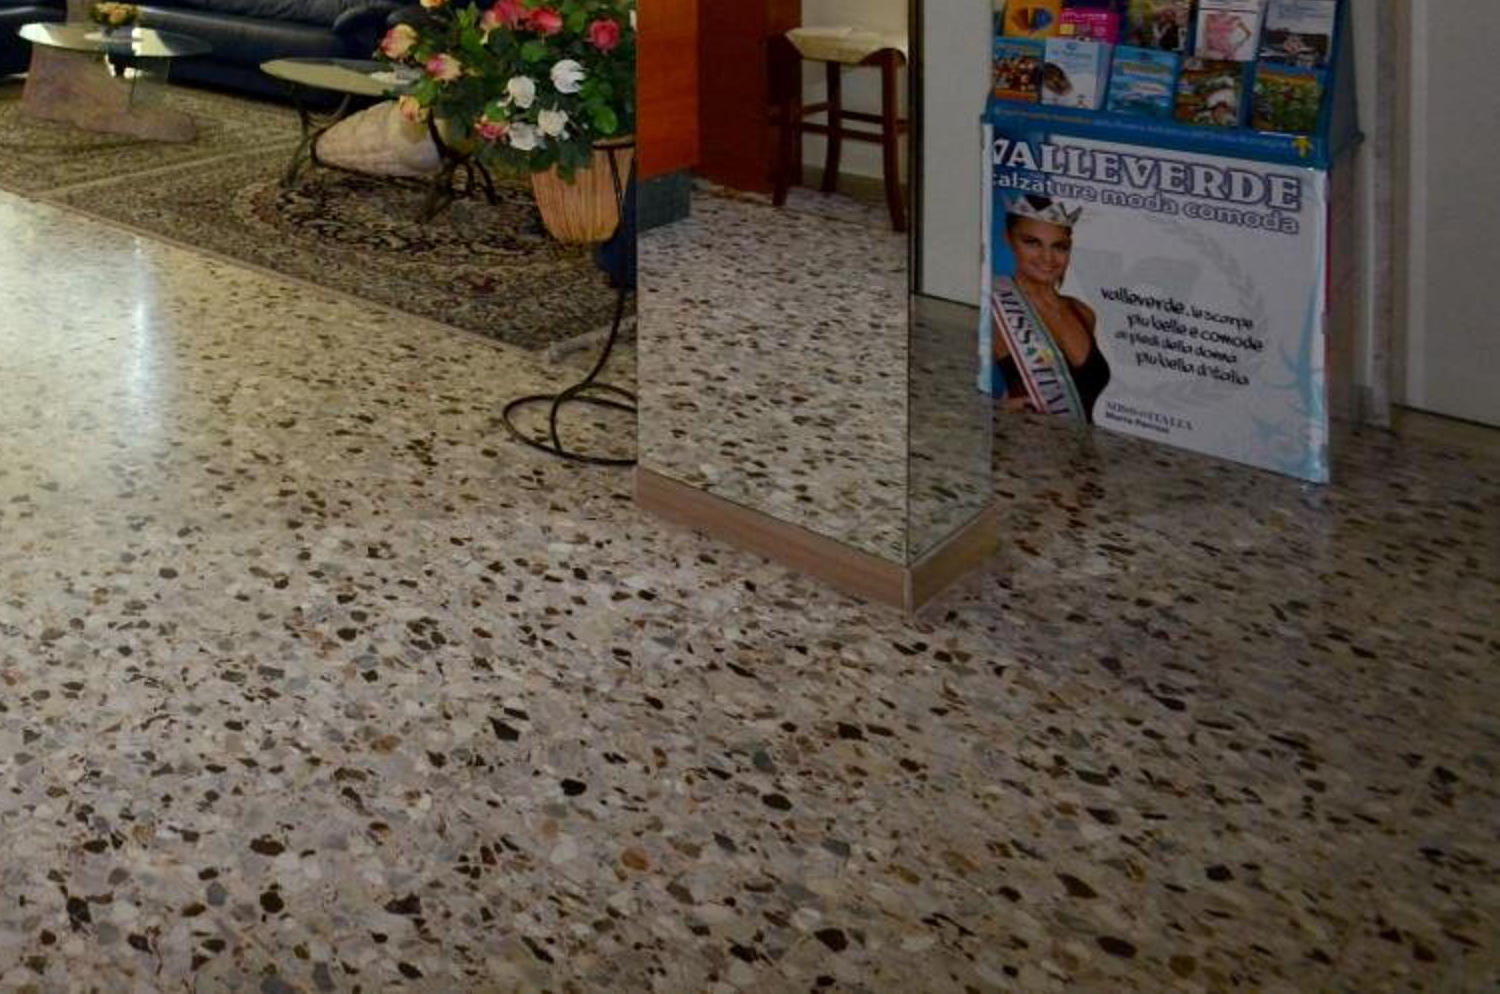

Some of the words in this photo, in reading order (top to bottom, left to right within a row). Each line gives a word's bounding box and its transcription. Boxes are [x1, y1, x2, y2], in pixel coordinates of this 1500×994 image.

[992, 171, 1097, 203] alzature
[1101, 188, 1179, 216] moda
[1183, 201, 1300, 235] comoda
